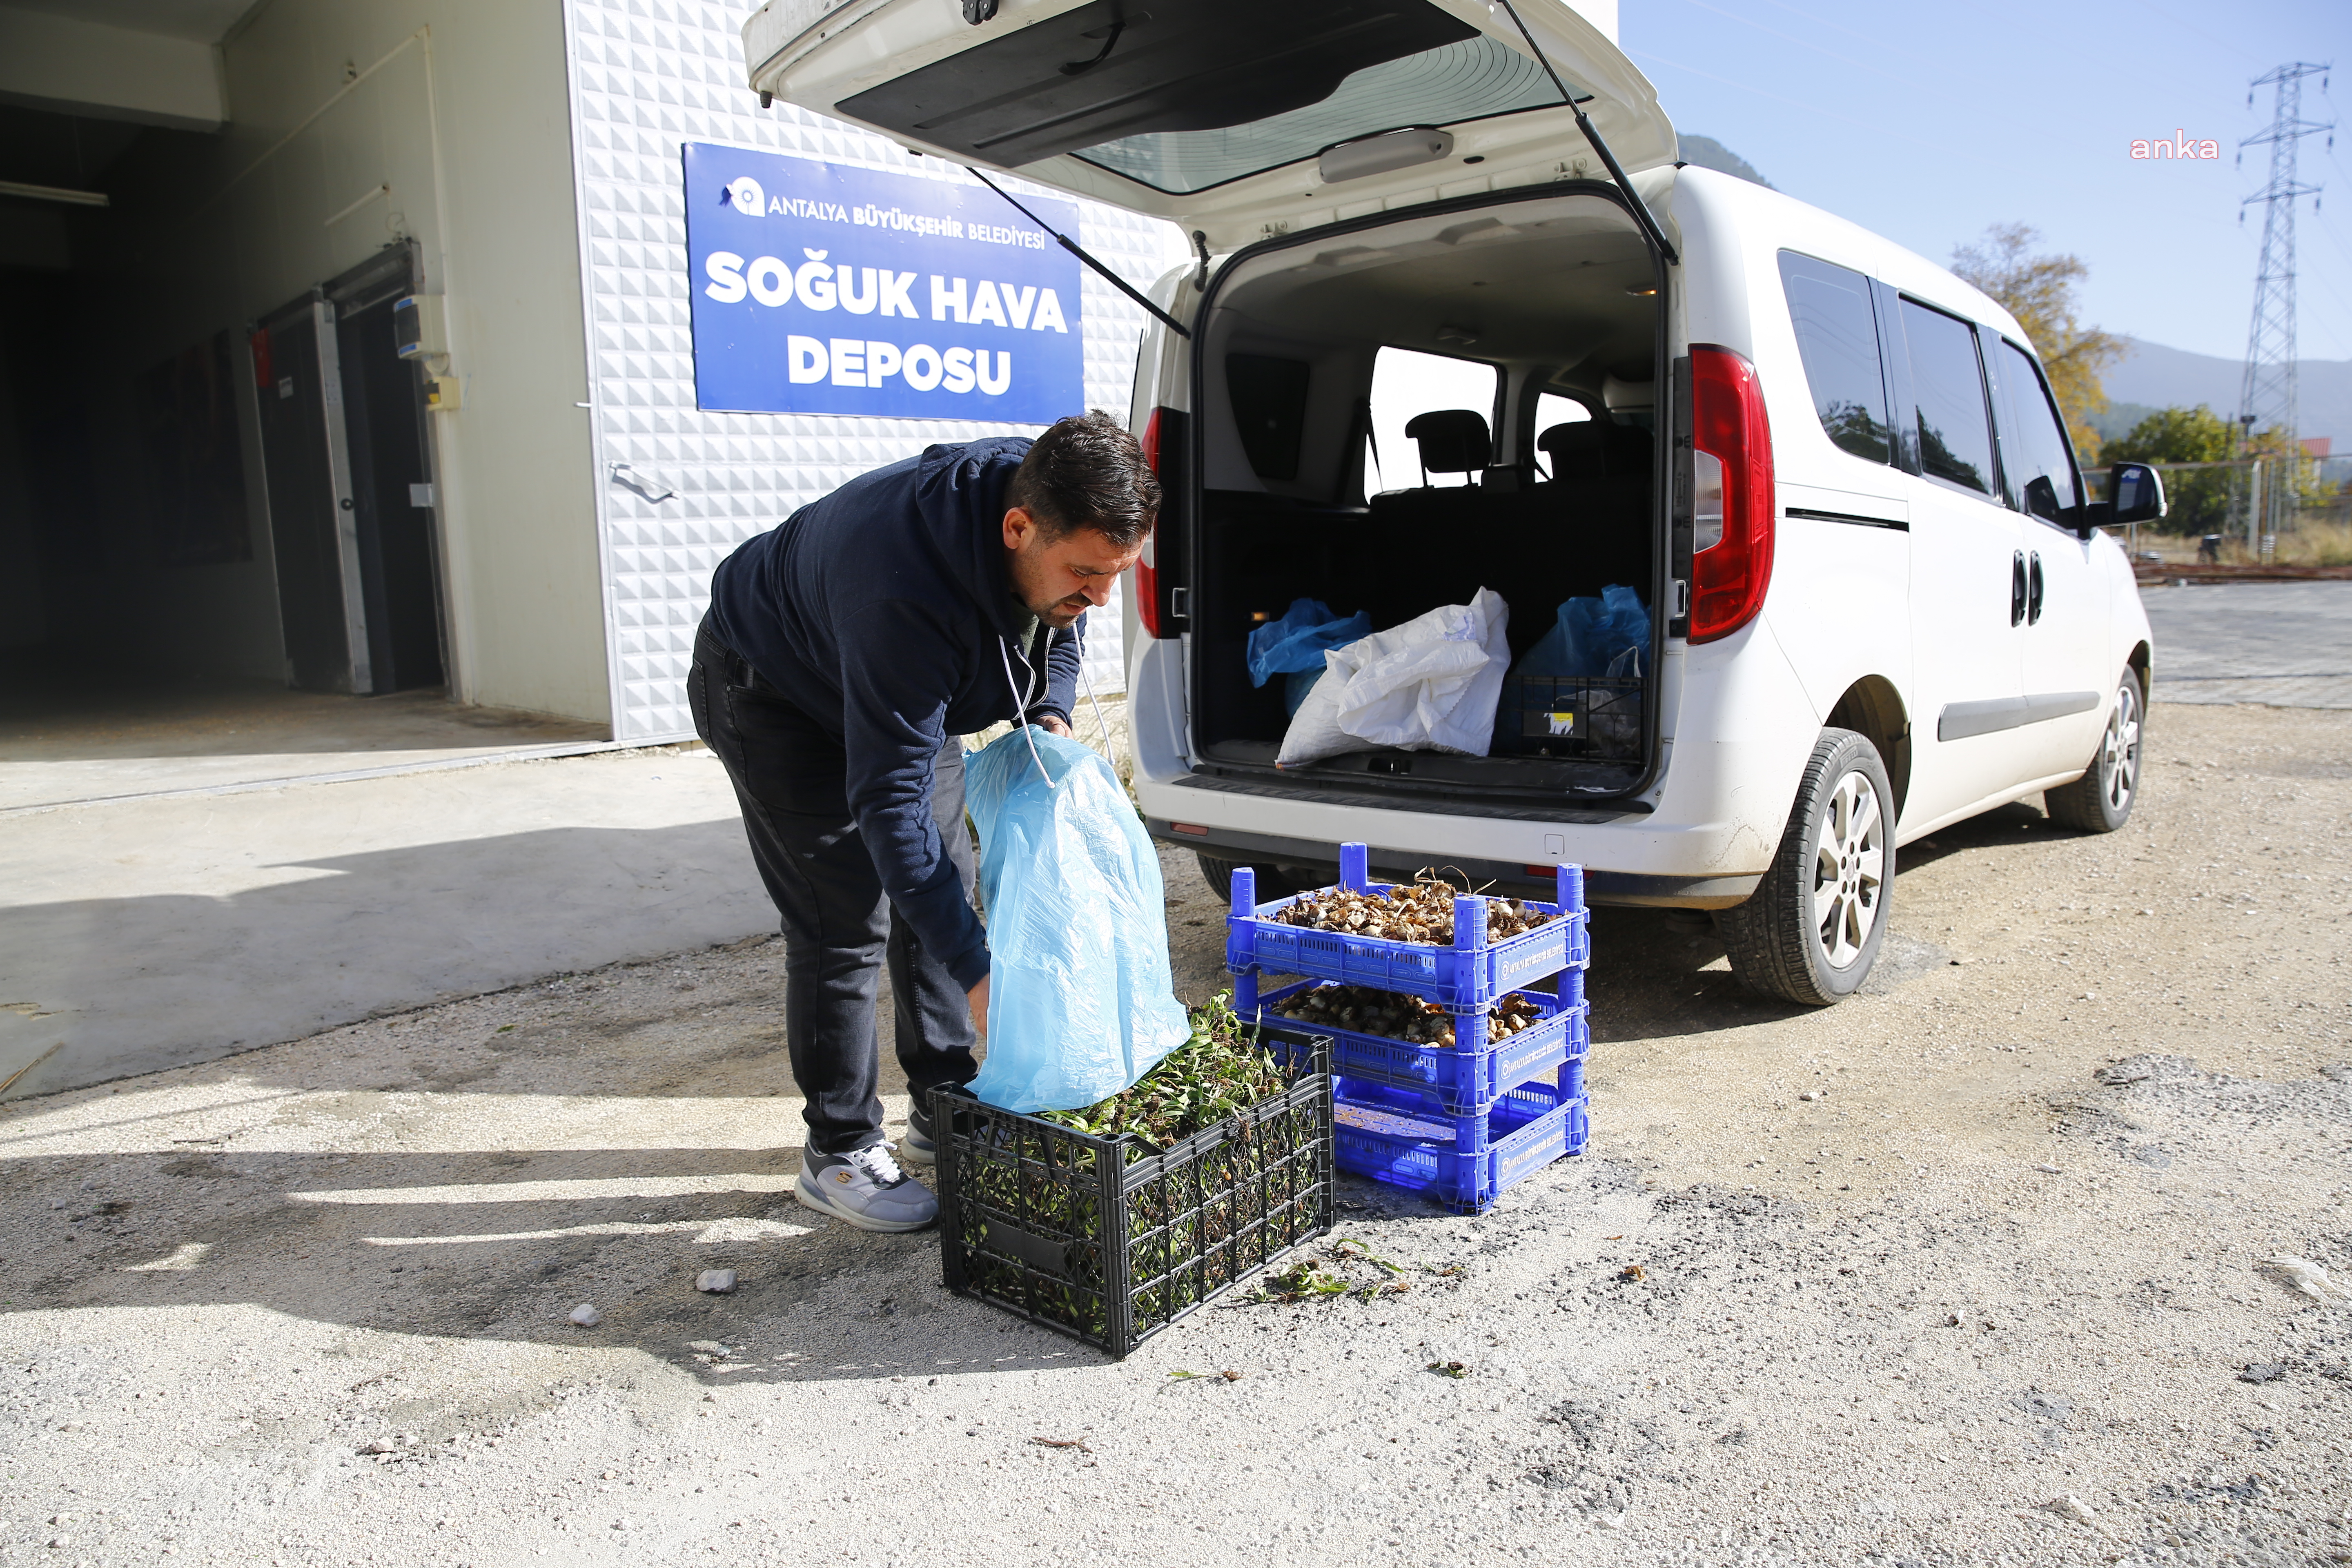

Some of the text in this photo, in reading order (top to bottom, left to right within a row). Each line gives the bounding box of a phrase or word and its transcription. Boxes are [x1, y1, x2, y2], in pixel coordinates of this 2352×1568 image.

[768, 195, 1045, 251] ANTALYA BÜYÜKŞEHİR BELEDİYESİ
[705, 247, 1068, 334] SOĞUK HAVA
[787, 334, 1011, 396] DEPOSU
[1509, 959, 1525, 974] ANTALYA
